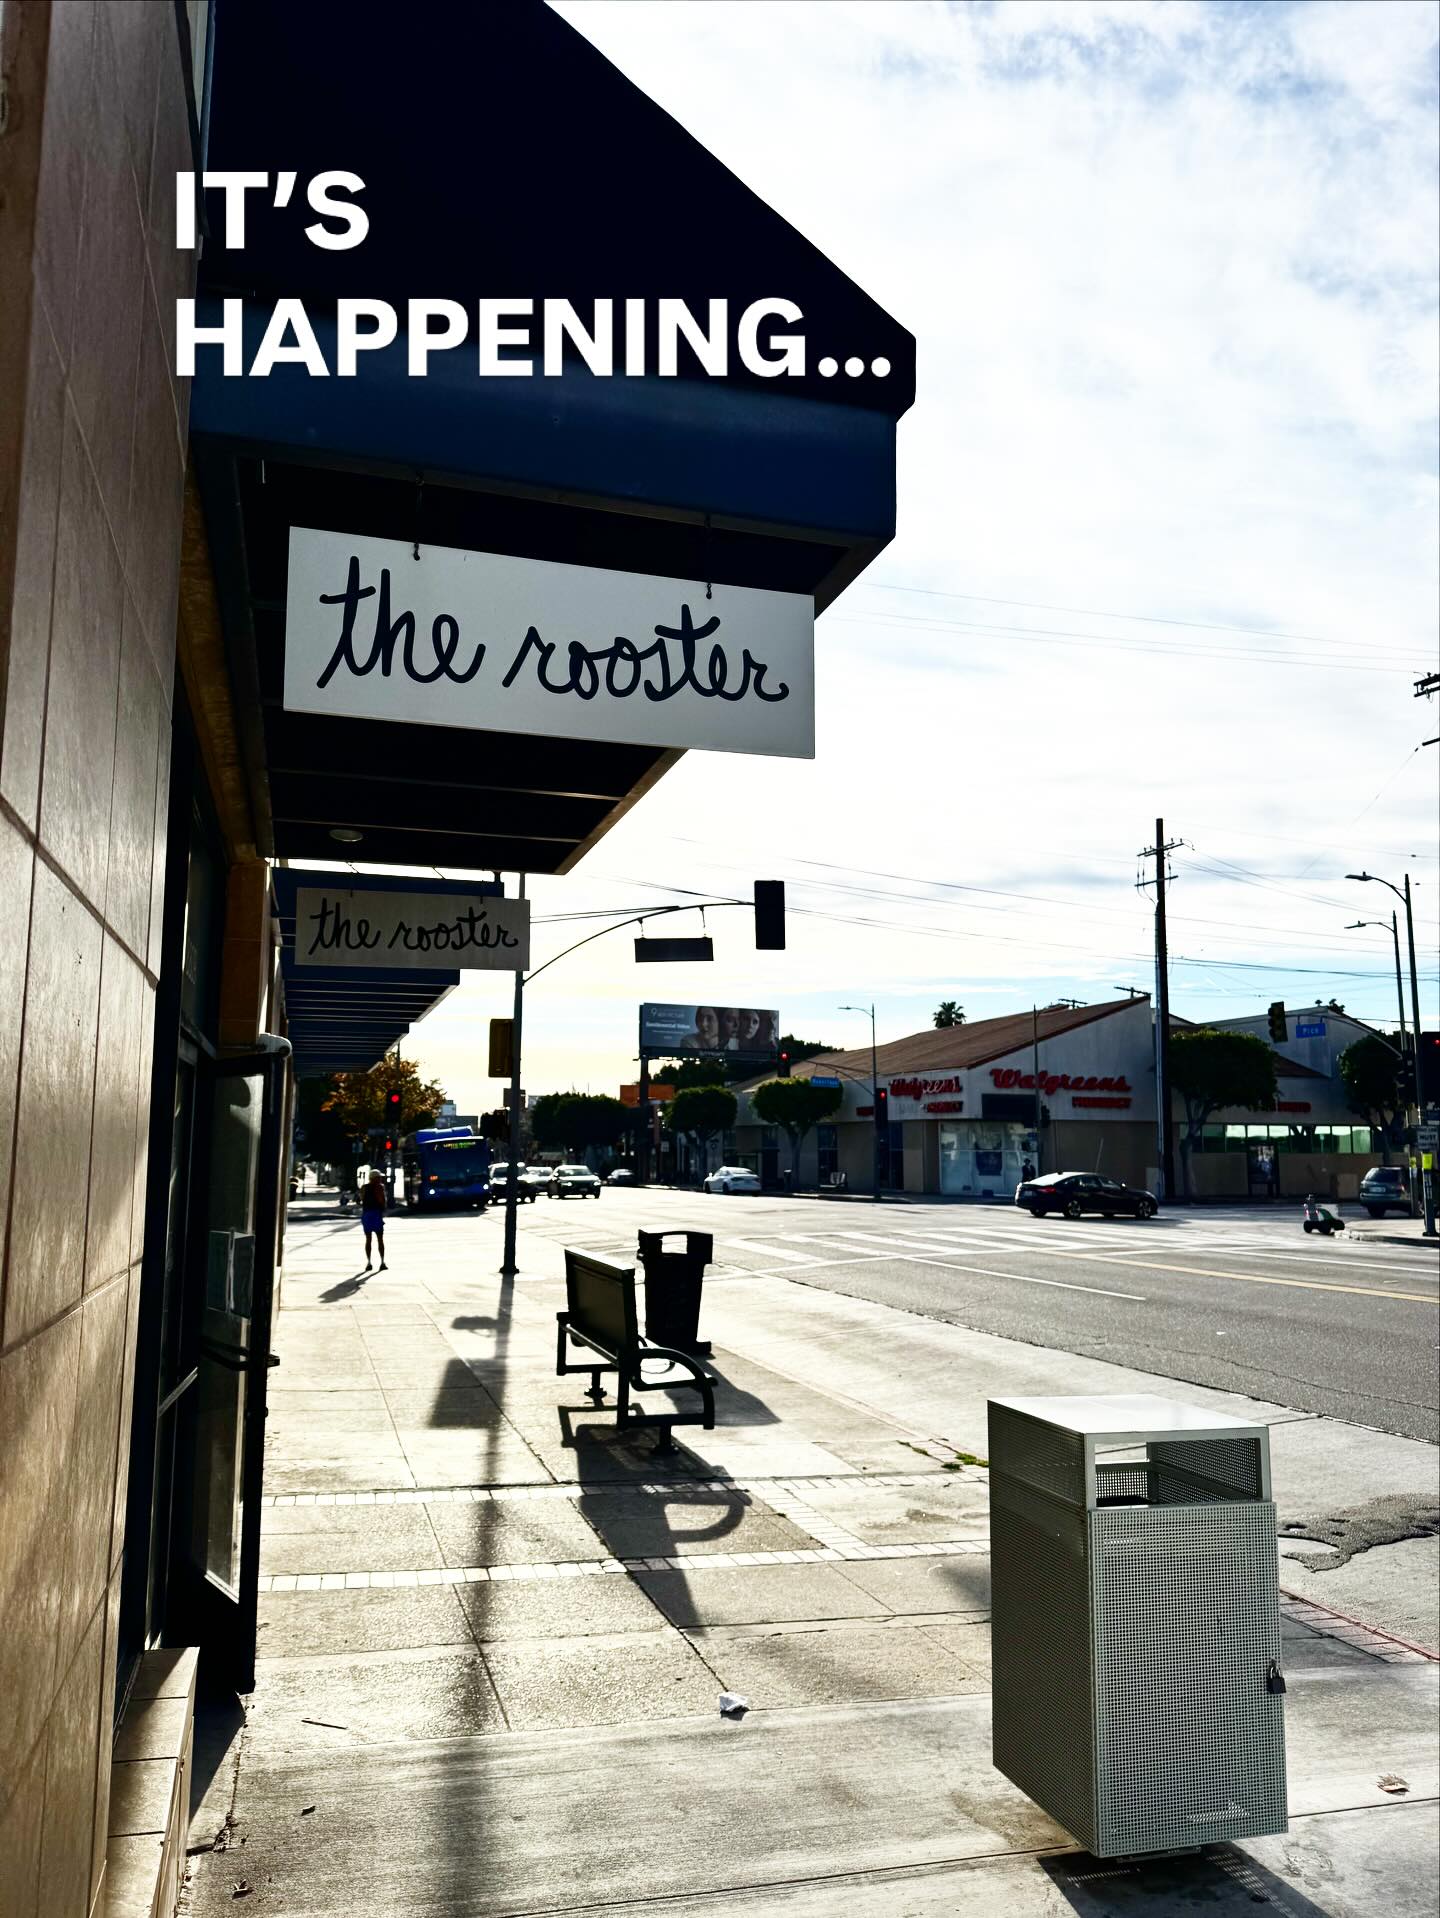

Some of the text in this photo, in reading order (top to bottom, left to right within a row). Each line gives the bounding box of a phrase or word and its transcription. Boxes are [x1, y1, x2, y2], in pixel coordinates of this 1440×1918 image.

[316, 555, 790, 702] the rooster
[308, 897, 519, 956] the rooster
[889, 1076, 963, 1100] Walgreens
[989, 1068, 1132, 1096] Walgreens
